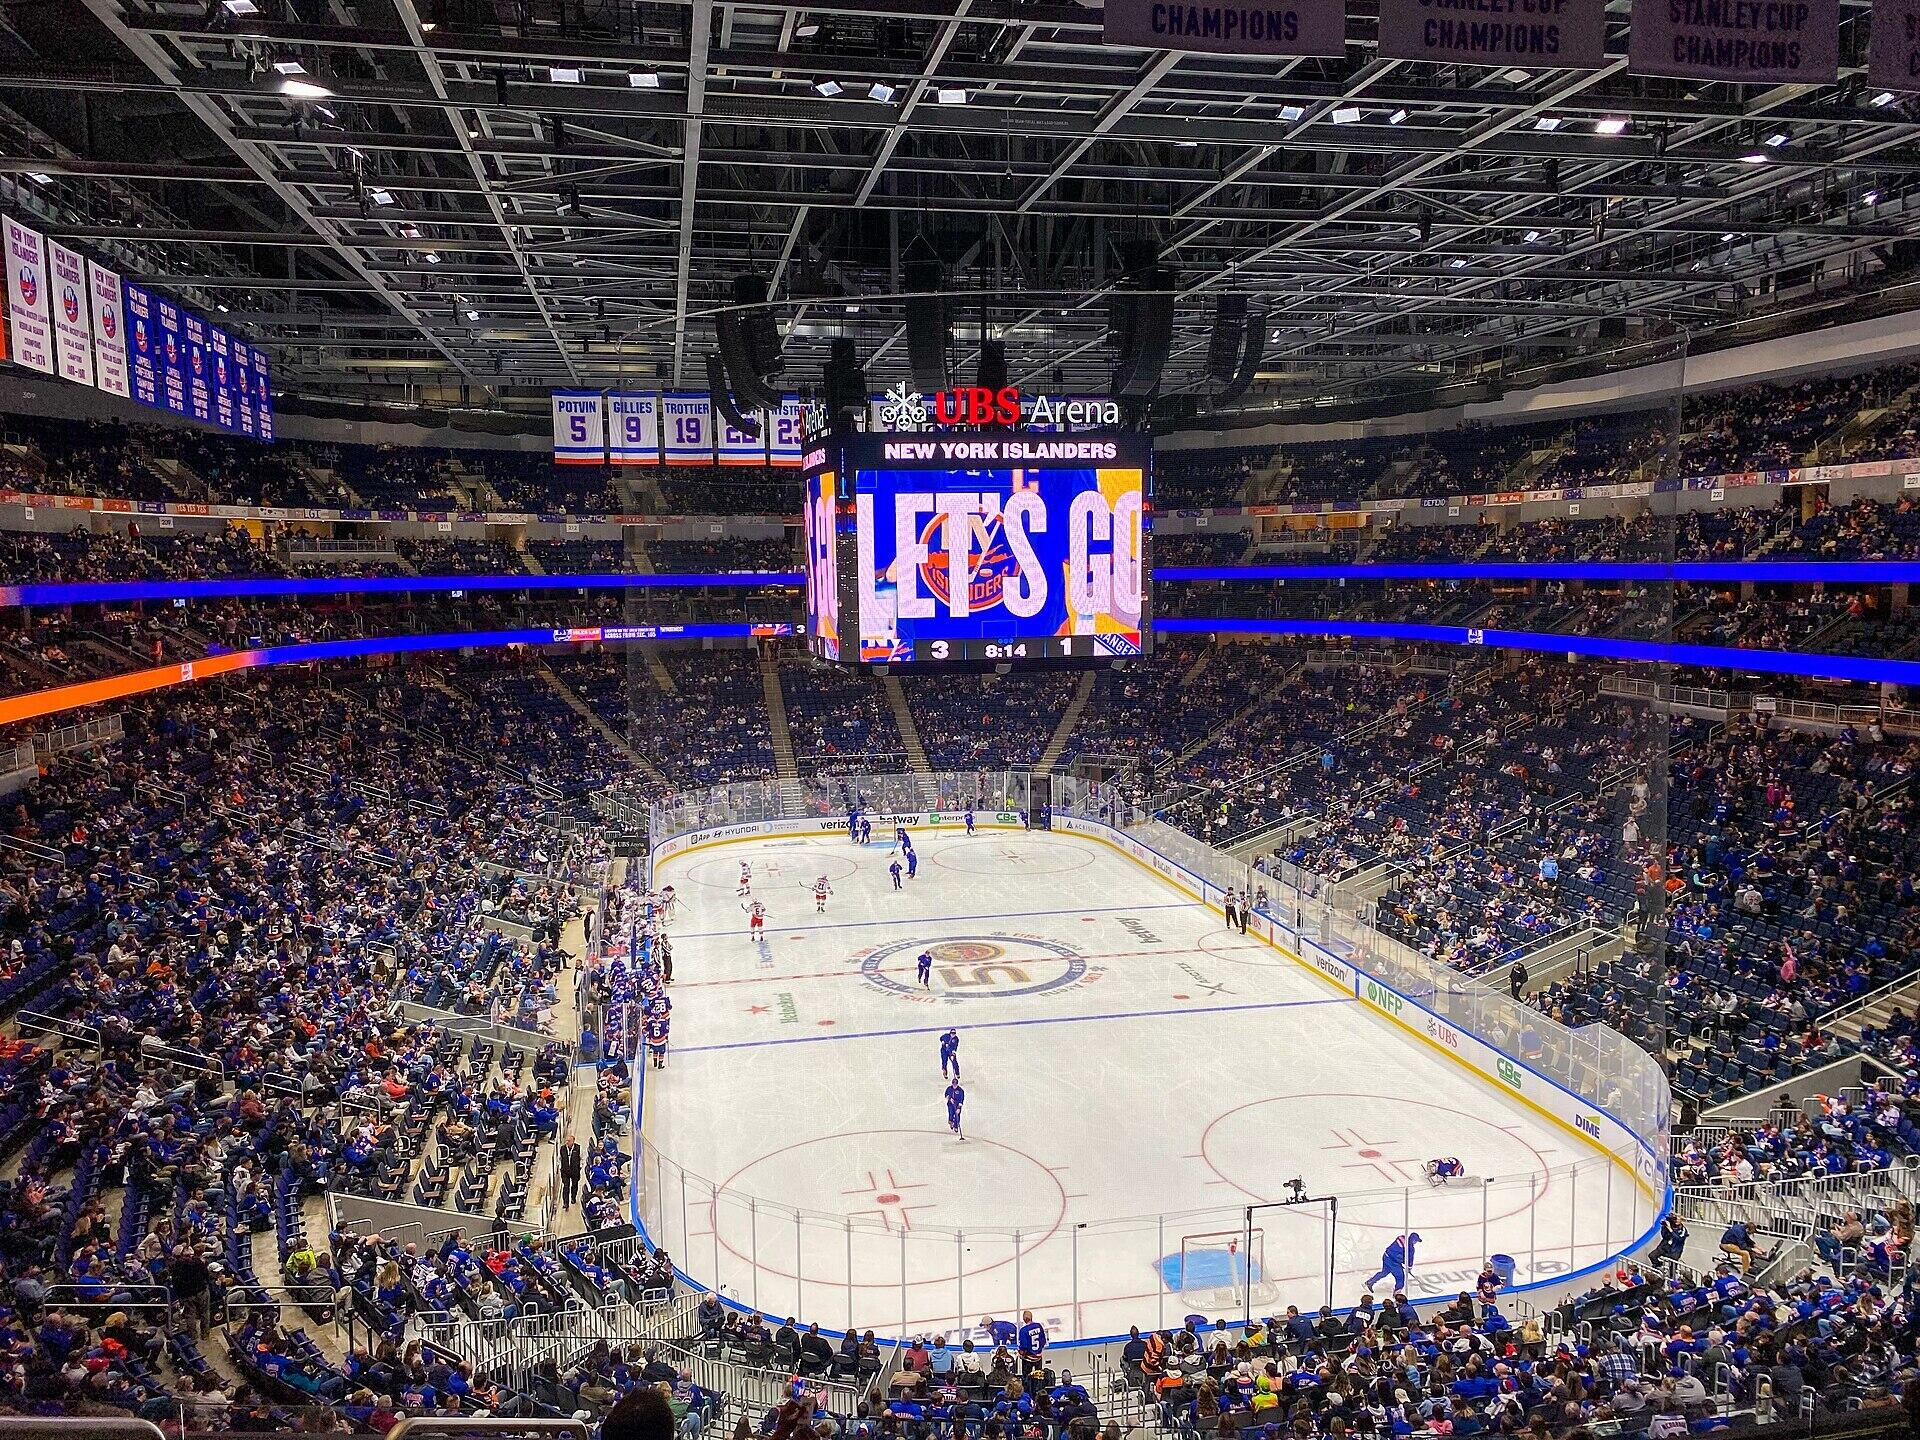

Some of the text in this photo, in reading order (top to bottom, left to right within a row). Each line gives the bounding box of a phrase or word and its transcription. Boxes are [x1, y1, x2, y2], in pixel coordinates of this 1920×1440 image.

[1152, 4, 1298, 41] CHAMPIONS
[1766, 4, 1810, 32] CUP
[1424, 18, 1560, 53] CHAMPIONS
[1672, 35, 1802, 70] CHAMPIONS
[10, 225, 36, 250] NEW YORK
[12, 242, 38, 265] ISLANDERS
[55, 248, 78, 270] NEW YORK
[56, 264, 80, 285] ISLANDERS
[95, 268, 115, 289] NEW YORK
[96, 284, 117, 303] ISLANDERS
[558, 400, 596, 414] POTVIN
[614, 402, 652, 414] GILLIES
[665, 402, 709, 414] TROTTIER
[936, 388, 1119, 426] UBS Arena
[570, 416, 586, 442] 5
[626, 417, 641, 442] 9
[675, 418, 701, 443] 19
[778, 419, 801, 444] 23
[885, 442, 1117, 459] NEW YORK ISLANDERS
[186, 504, 195, 512] YES
[197, 504, 206, 513] YES
[856, 491, 1142, 619] LET'S GO
[796, 624, 805, 633] 3
[931, 641, 949, 659] 3
[985, 644, 1026, 657] 8:14
[1060, 639, 1071, 655] 1
[880, 815, 920, 825] betway
[725, 826, 759, 836] HYUNDAI
[268, 925, 278, 934] 15
[1116, 917, 1162, 944] betway
[1315, 954, 1345, 982] verizon
[642, 980, 653, 992] 32
[860, 982, 901, 996] Arena
[1039, 973, 1104, 997] UBS Arena
[655, 1003, 666, 1013] 28
[900, 995, 936, 1004] UBS
[1378, 988, 1403, 1016] NFP
[654, 1027, 661, 1036] 6
[1437, 1024, 1458, 1048] UBS
[1576, 1114, 1600, 1140] DIME
[1032, 1336, 1040, 1351] 5
